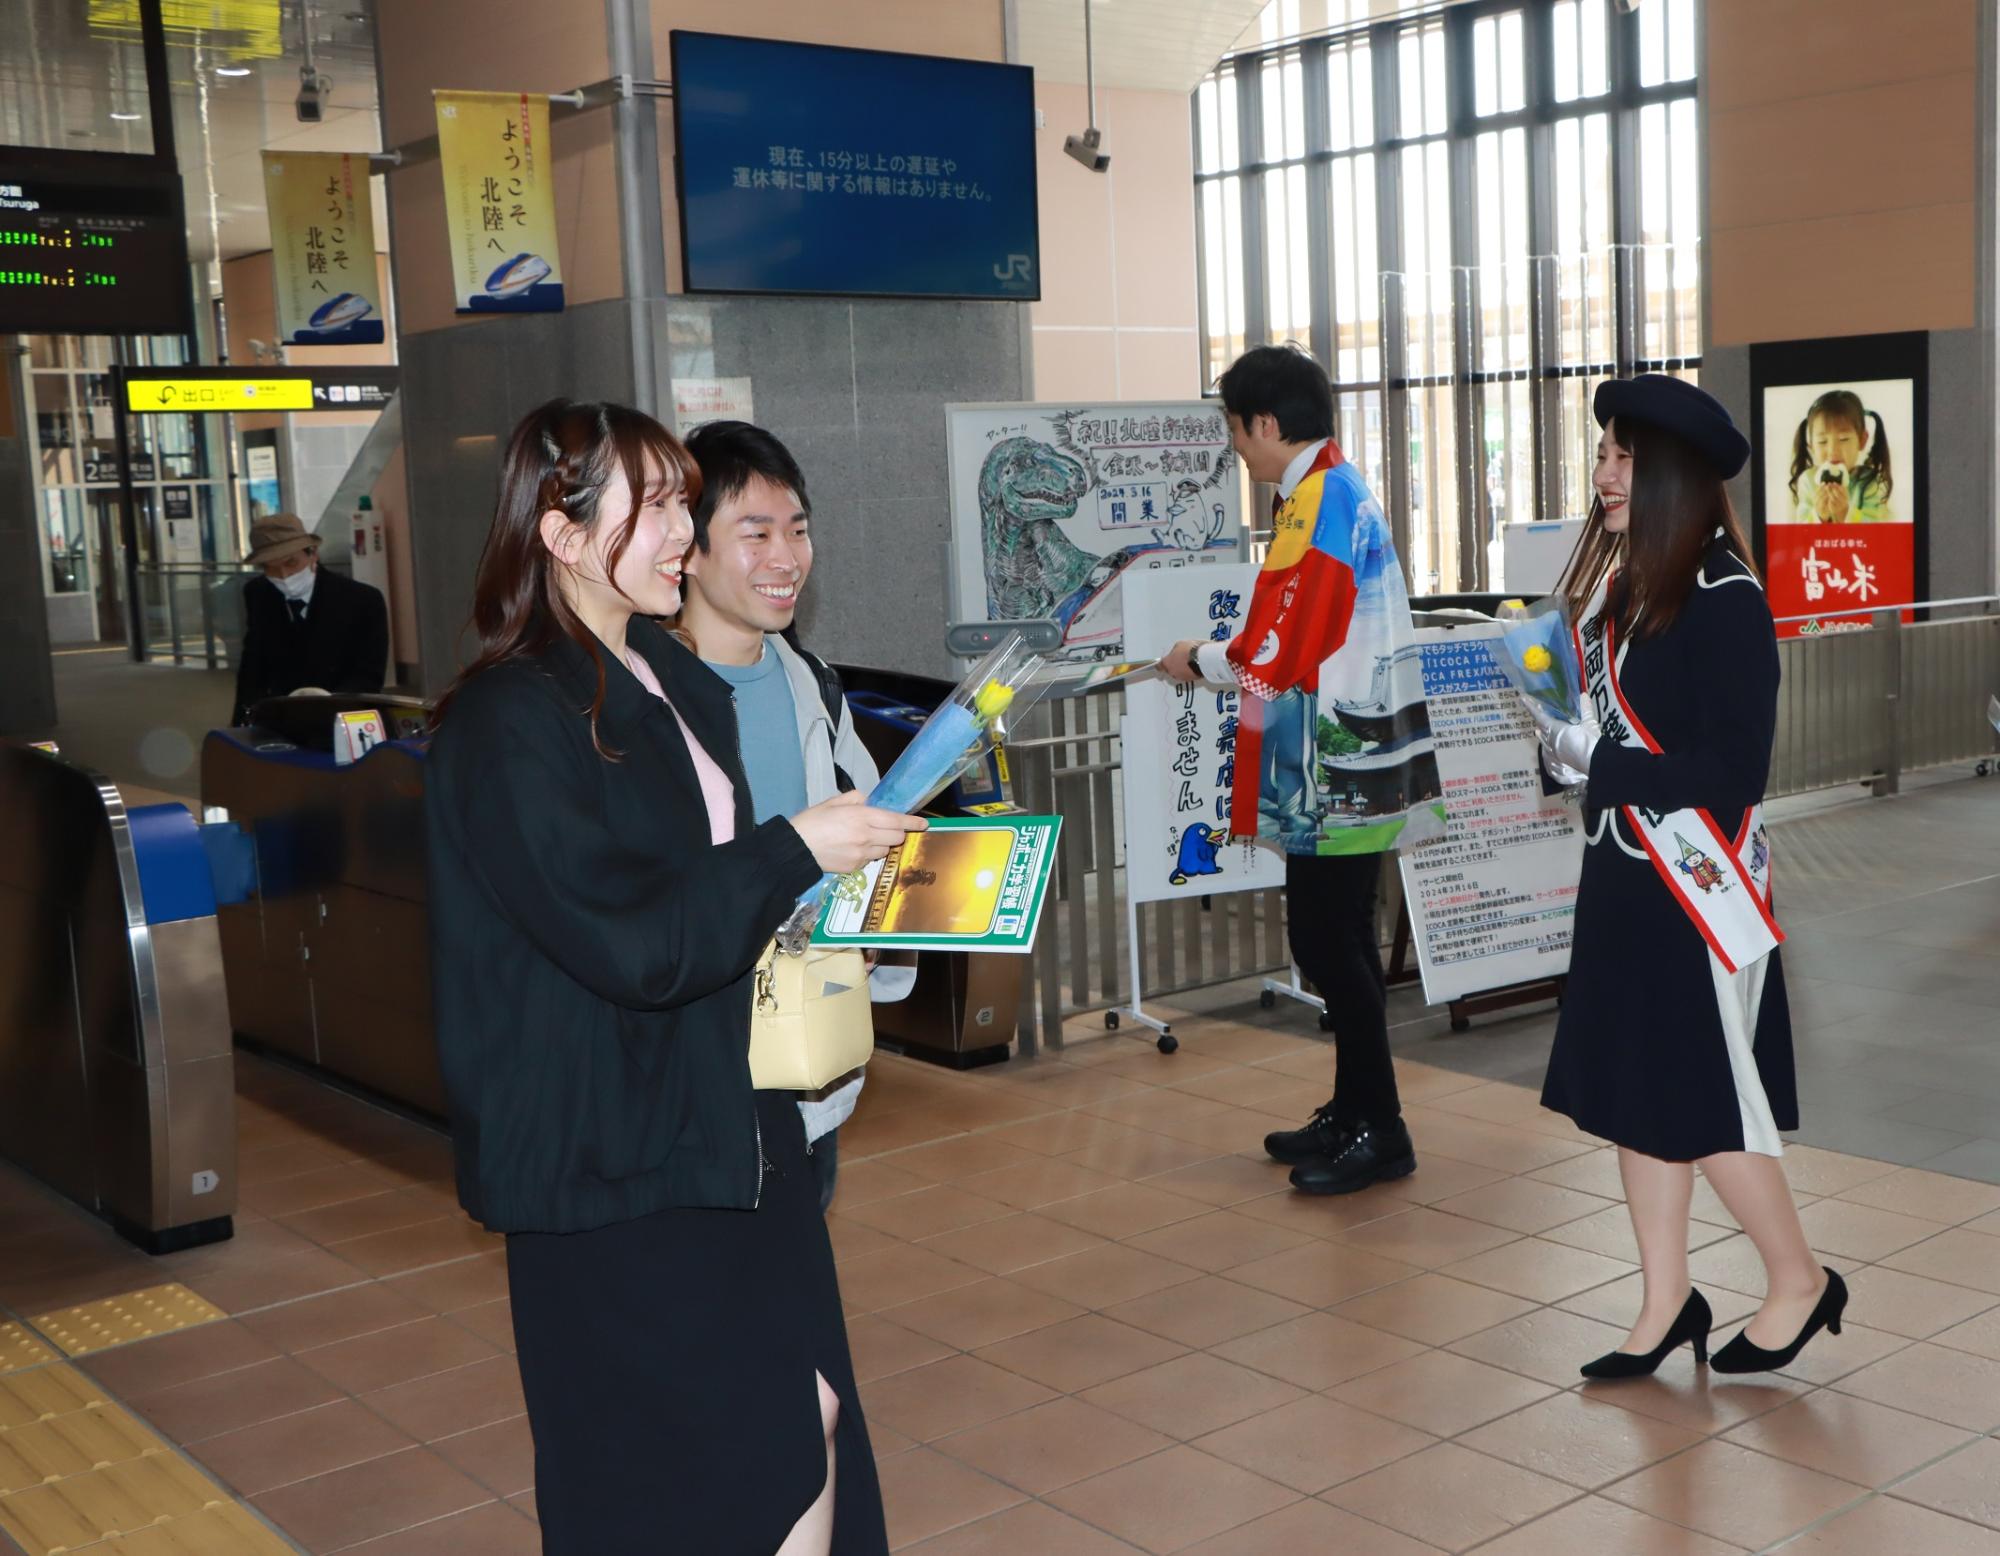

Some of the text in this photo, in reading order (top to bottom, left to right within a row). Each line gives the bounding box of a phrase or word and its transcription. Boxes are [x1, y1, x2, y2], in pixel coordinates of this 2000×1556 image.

[501, 118, 528, 226] ようこそ
[768, 145, 958, 176] 現在、15分以上の遅延や
[732, 166, 992, 202] 運休等に関する情報はありません。
[325, 176, 350, 270] ようこそ
[480, 176, 506, 254] 北陸へ
[305, 225, 329, 294] 北陸へ
[993, 253, 1032, 282] JR
[183, 389, 214, 403] 出口
[86, 463, 99, 481] 2
[1801, 546, 1879, 602] 富山米
